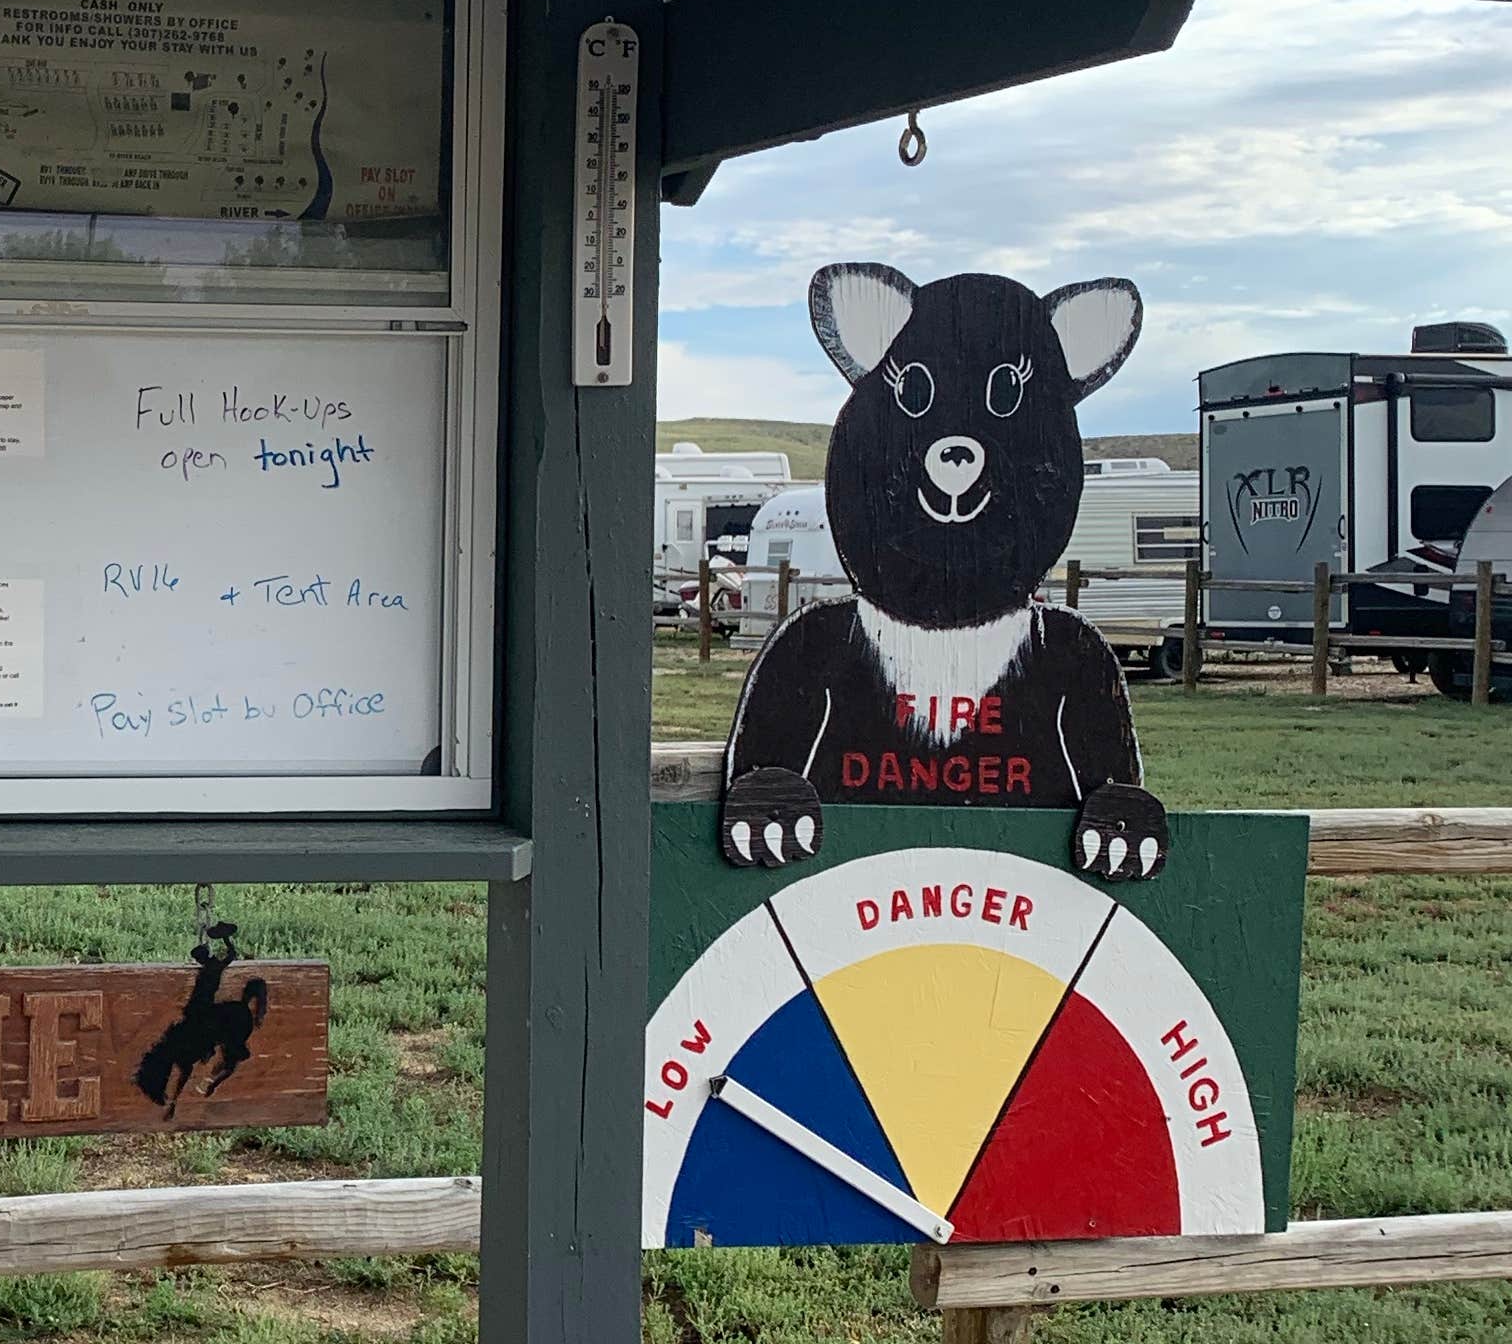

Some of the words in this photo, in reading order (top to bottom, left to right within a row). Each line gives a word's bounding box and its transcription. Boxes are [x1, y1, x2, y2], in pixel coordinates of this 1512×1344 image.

[128, 1, 164, 15] ONLY
[3, 7, 162, 26] RESTROOMS/SHOWERS
[167, 16, 187, 29] BY
[188, 17, 240, 33] OFFICE
[16, 20, 45, 34] FOR
[49, 23, 84, 36] INFO
[88, 25, 123, 39] CALL
[37, 35, 65, 49] YOU
[69, 37, 115, 51] ENJOY
[120, 39, 158, 54] YOUR
[161, 42, 197, 55] STAY
[200, 44, 237, 58] WITH
[240, 46, 259, 58] US
[360, 167, 381, 183] PAY
[384, 167, 417, 185] SLOT
[377, 185, 396, 202] ON
[585, 184, 596, 193] 10
[220, 206, 259, 219] RIVER
[587, 210, 594, 219] 0
[585, 236, 595, 245] 10
[616, 227, 626, 236] 20
[584, 261, 594, 271] 20
[616, 256, 623, 265] 0
[136, 385, 196, 430] Full
[160, 447, 227, 482] open
[254, 434, 375, 489] tonight
[1234, 466, 1311, 504] XLR
[1252, 499, 1299, 523] NITRO
[253, 573, 332, 607] Tent
[346, 577, 409, 611] Area
[89, 691, 152, 739] Pay
[894, 693, 1004, 736] FIRE
[841, 750, 1033, 795] DANGER
[854, 882, 1035, 932] DANGER
[643, 1018, 715, 1121] LOW
[1159, 1018, 1234, 1149] HIGH
